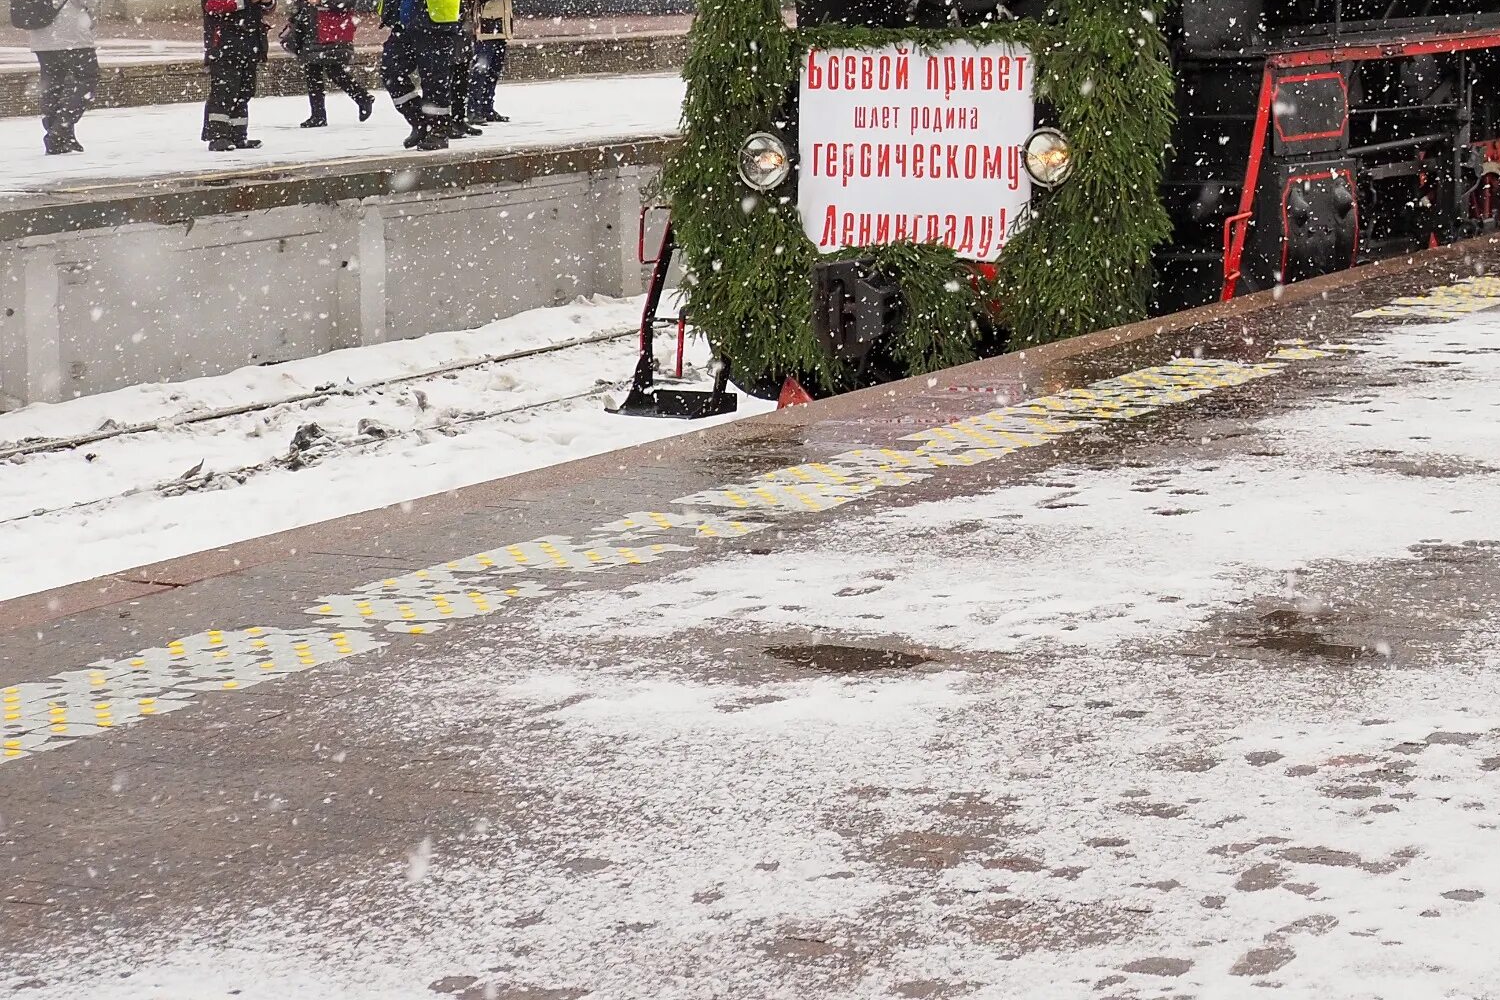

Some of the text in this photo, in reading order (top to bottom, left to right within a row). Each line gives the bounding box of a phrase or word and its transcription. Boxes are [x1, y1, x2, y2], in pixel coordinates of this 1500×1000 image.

[807, 47, 1028, 101] Боевой привет
[854, 105, 978, 135] шлет родина
[812, 143, 1020, 191] героическому
[819, 204, 1007, 258] Ленинграду!
